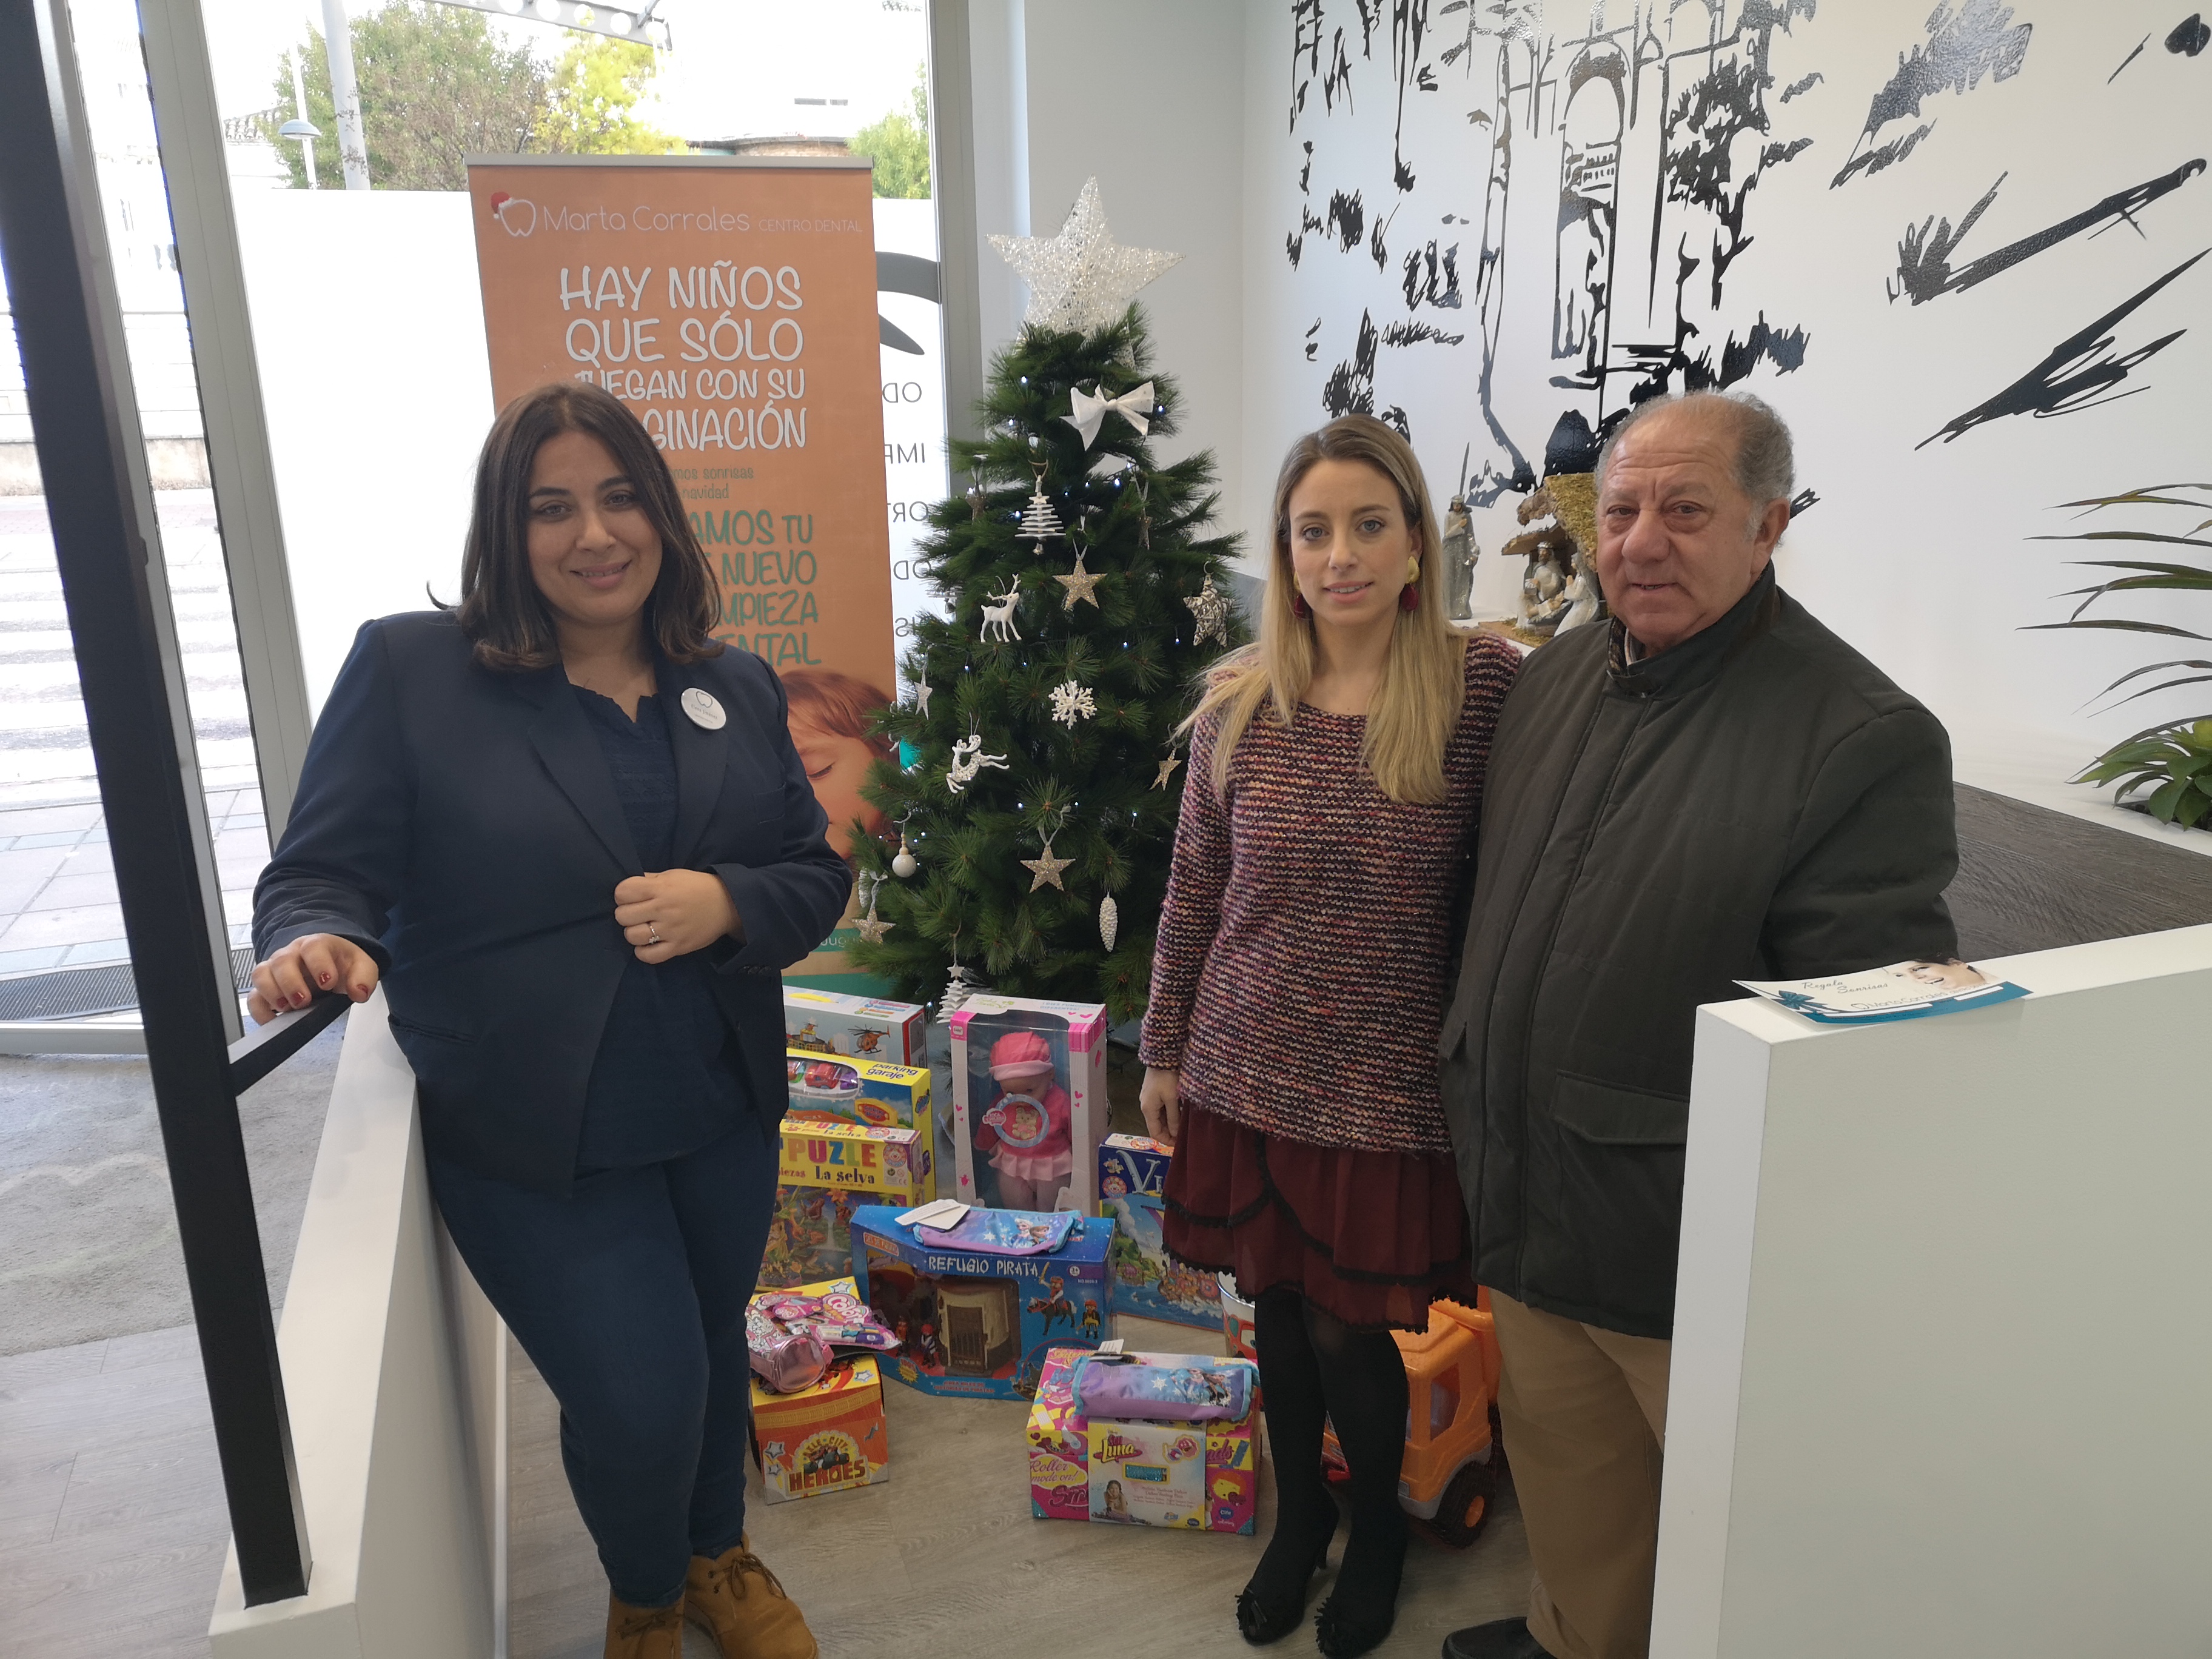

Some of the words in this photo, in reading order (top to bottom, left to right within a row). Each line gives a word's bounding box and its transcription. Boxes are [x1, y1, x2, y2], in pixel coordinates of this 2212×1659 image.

[543, 206, 626, 232] Marta
[632, 205, 750, 232] Corrales
[759, 219, 813, 232] CENTRO
[814, 219, 863, 233] DENTAL
[560, 265, 652, 312] HAY
[668, 260, 803, 312] NIÑOS
[565, 318, 665, 368] QUE
[680, 310, 804, 363] SÓLO
[695, 369, 758, 401] CON
[768, 368, 805, 401] SU
[642, 400, 806, 451] GINACIÓN
[703, 465, 754, 480] sonrisas
[682, 483, 729, 500] navidad
[689, 510, 776, 546] AMOS
[782, 514, 813, 544] TU
[722, 550, 818, 586] NUEVO
[716, 589, 819, 628] MPIEZA
[715, 632, 822, 667] NTAL
[1801, 980, 1844, 991] Regala
[1837, 982, 1888, 994] Sonrisas
[865, 1067, 904, 1080] garaje
[873, 1063, 919, 1076] parking
[787, 1138, 877, 1168] PUZLE
[815, 1165, 831, 1181] La
[836, 1167, 875, 1185] selva
[928, 1256, 990, 1274] REFUGIO
[996, 1260, 1039, 1277] PIRATA
[1101, 1438, 1136, 1463] Luna
[788, 1458, 866, 1492] HEROES
[1030, 1458, 1069, 1473] Roller
[1031, 1472, 1058, 1482] mode
